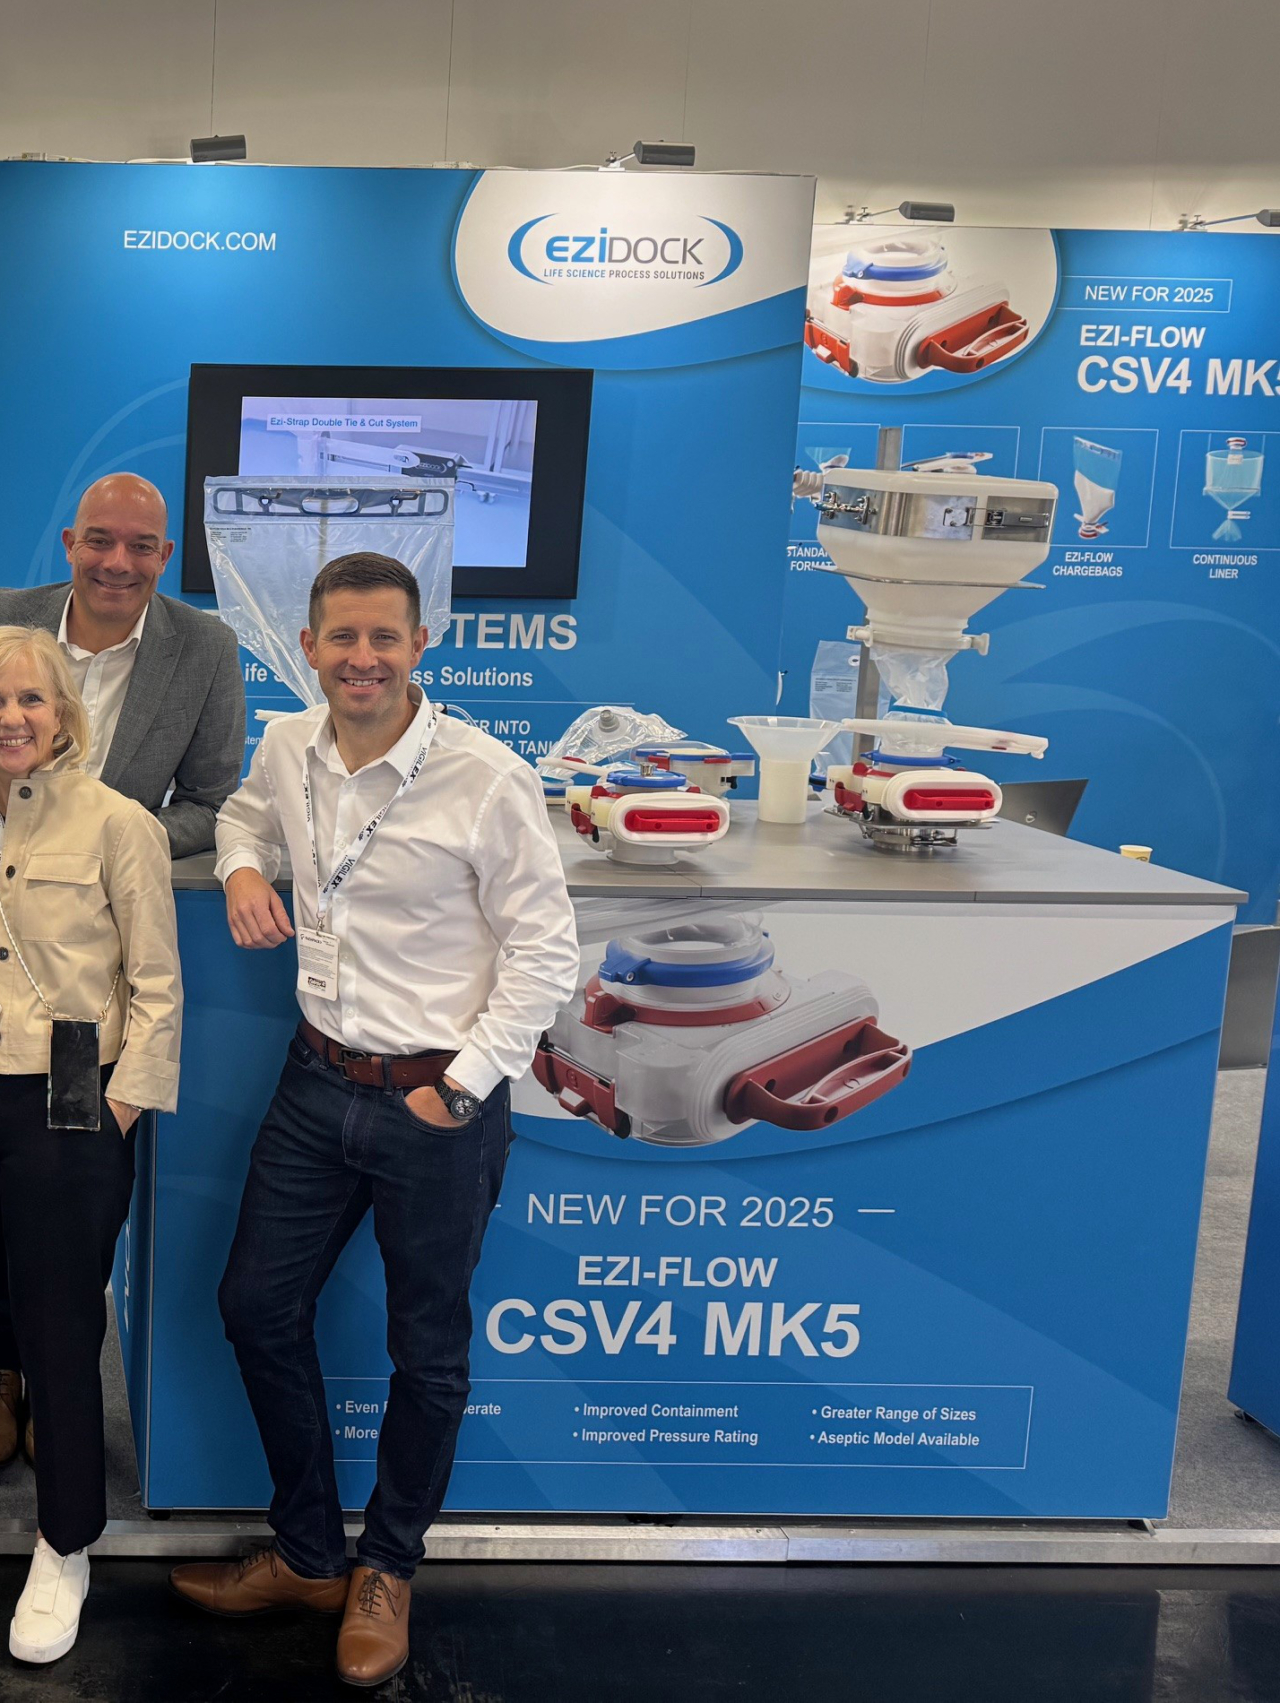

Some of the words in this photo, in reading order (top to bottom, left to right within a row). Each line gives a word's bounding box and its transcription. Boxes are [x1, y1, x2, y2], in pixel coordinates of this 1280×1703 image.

[123, 229, 277, 251] EZIDOCK.COM
[543, 268, 564, 278] LIFE
[566, 269, 606, 279] SCIENCE
[608, 269, 651, 279] PROCESS
[653, 270, 705, 281] SOLUTIONS
[1085, 285, 1128, 301] NEW
[1131, 286, 1170, 302] FOR
[1173, 287, 1214, 303] 2025
[1080, 324, 1207, 349] EZI-FLOW
[1077, 354, 1192, 395] CSV4
[270, 417, 310, 428] Ezi-Strap
[312, 418, 342, 427] Double
[345, 418, 358, 427] Tie
[359, 419, 366, 427] &
[368, 419, 384, 428] Cut
[386, 419, 418, 429] System
[1064, 551, 1114, 563] EZI-FLOW
[1192, 554, 1258, 566] CONTINUOUS
[1052, 565, 1123, 577] CHARGEBAGS
[1209, 568, 1239, 579] LINER
[428, 613, 578, 650] TEMS
[245, 663, 268, 682] ife
[440, 666, 534, 687] Solutions
[494, 719, 530, 735] INTO
[331, 858, 356, 890] VIGILEX
[527, 1193, 627, 1225] NEW
[639, 1194, 727, 1227] FOR
[740, 1196, 835, 1228] 2025
[577, 1255, 779, 1288] EZI-FLOW
[485, 1298, 678, 1356] CSV4
[703, 1301, 861, 1358] MK5
[345, 1400, 379, 1414] Even
[463, 1402, 501, 1415] erate
[583, 1403, 648, 1419] Improved
[651, 1403, 739, 1418] Containment
[821, 1405, 872, 1419] Greater
[875, 1406, 919, 1423] Range
[922, 1407, 937, 1420] of
[940, 1407, 977, 1421] Sizes
[344, 1426, 379, 1440] More
[581, 1428, 646, 1444] Improved
[649, 1429, 710, 1443] Pressure
[714, 1430, 759, 1446] Rating
[817, 1431, 870, 1447] Aseptic
[873, 1432, 915, 1446] Model
[917, 1432, 980, 1447] Available
